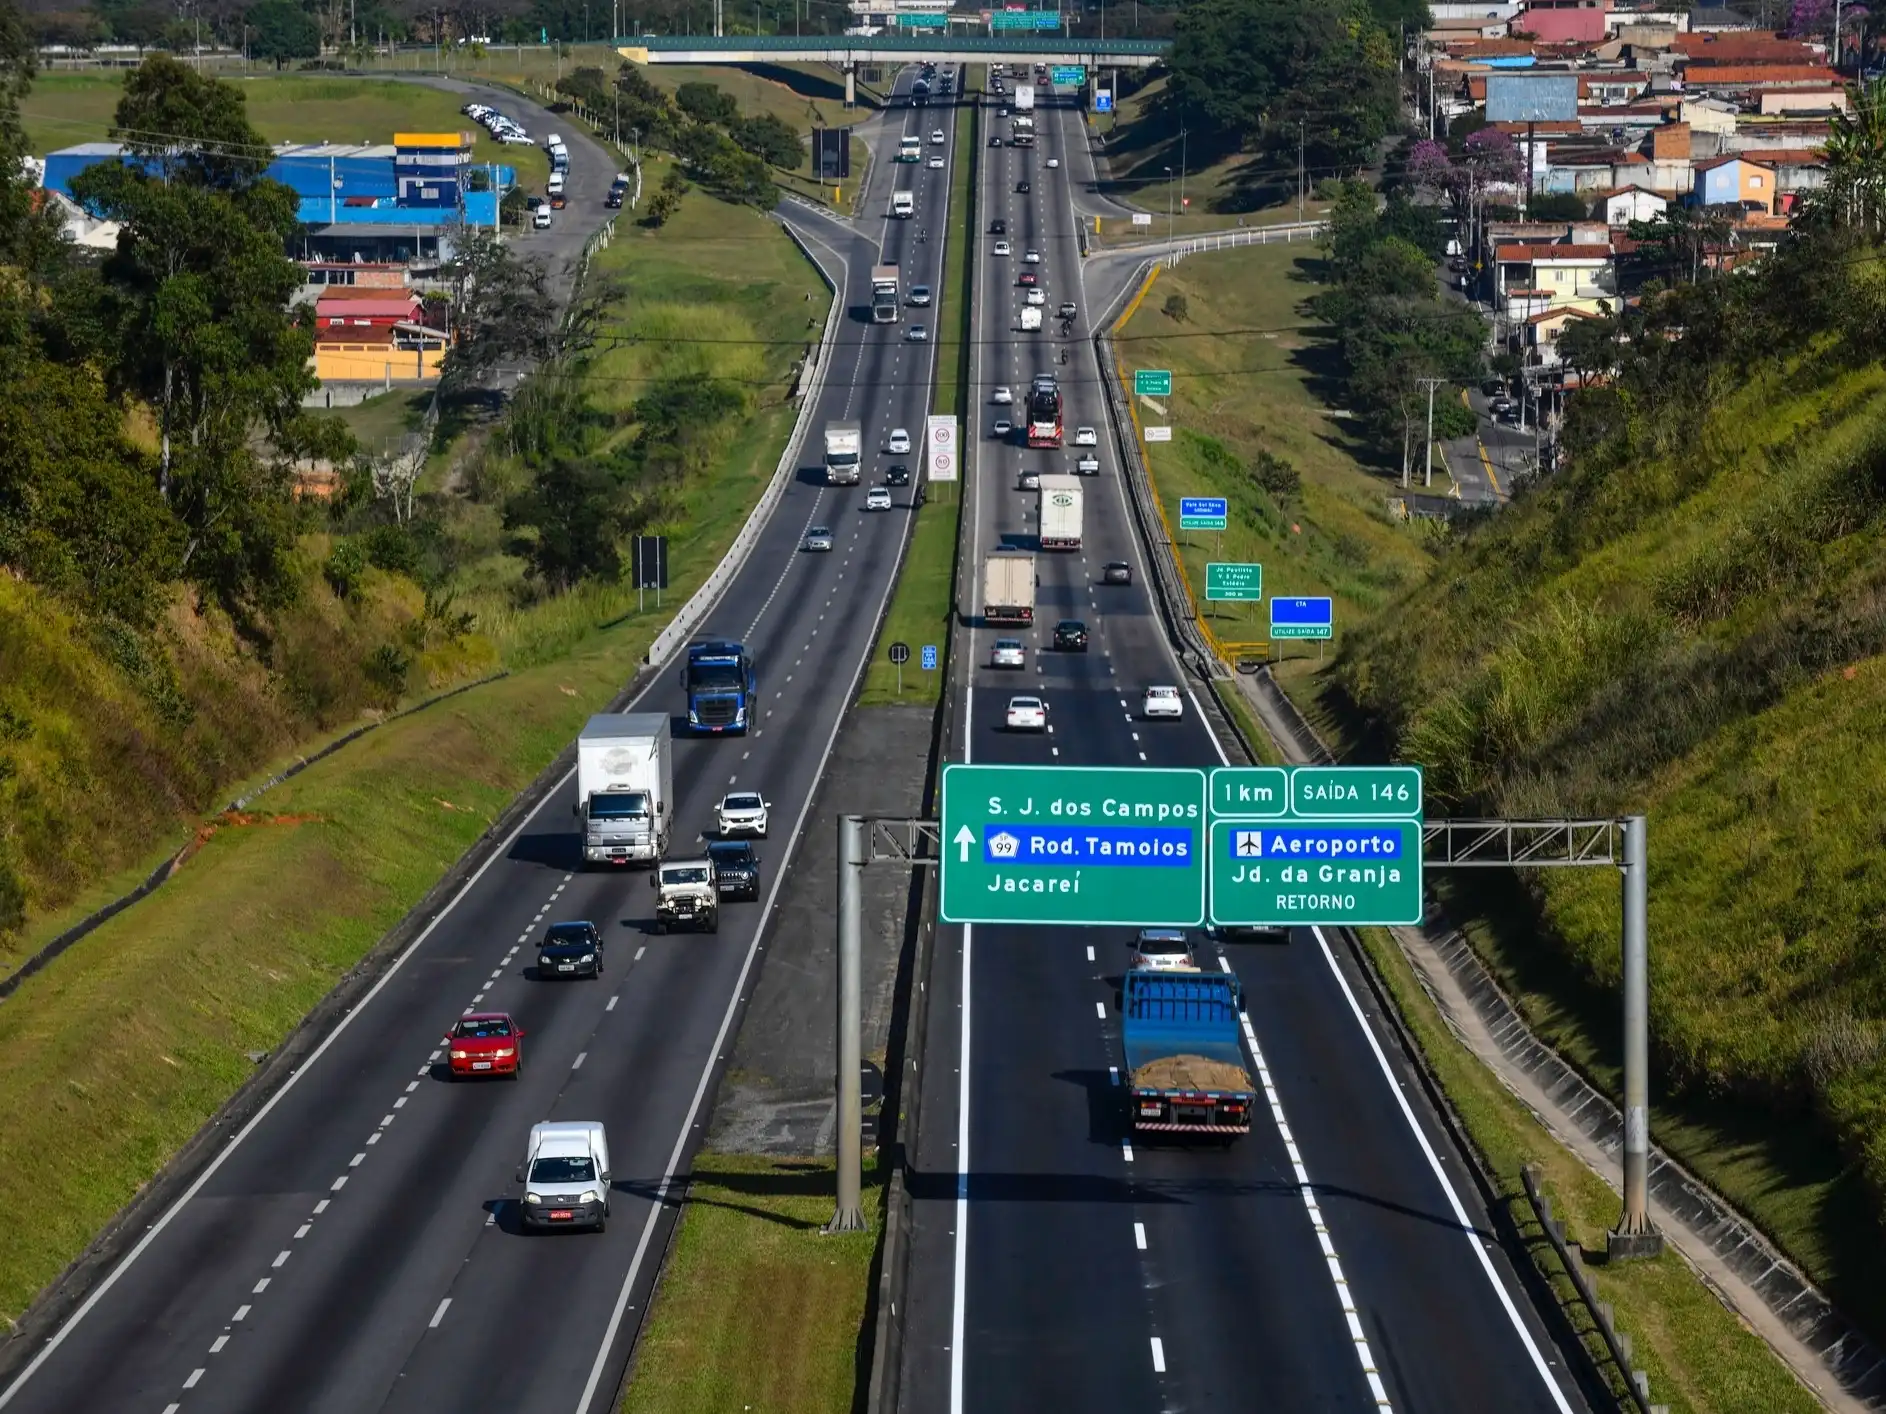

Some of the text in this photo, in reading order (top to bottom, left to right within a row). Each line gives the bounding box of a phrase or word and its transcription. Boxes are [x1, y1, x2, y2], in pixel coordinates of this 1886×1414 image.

[1297, 627, 1315, 635] SAÍDA
[1225, 783, 1273, 801] 1 km
[1303, 779, 1410, 801] SAÍDA 146
[987, 796, 1198, 821] S. J. dos Campos
[996, 842, 1012, 853] 99
[1030, 836, 1188, 857] Rod. Tamoios
[1270, 835, 1395, 857] Aeroporto
[987, 870, 1081, 894] Jacareí
[1232, 865, 1401, 889] Jd. da Granja
[1276, 894, 1356, 910] RETORNO
